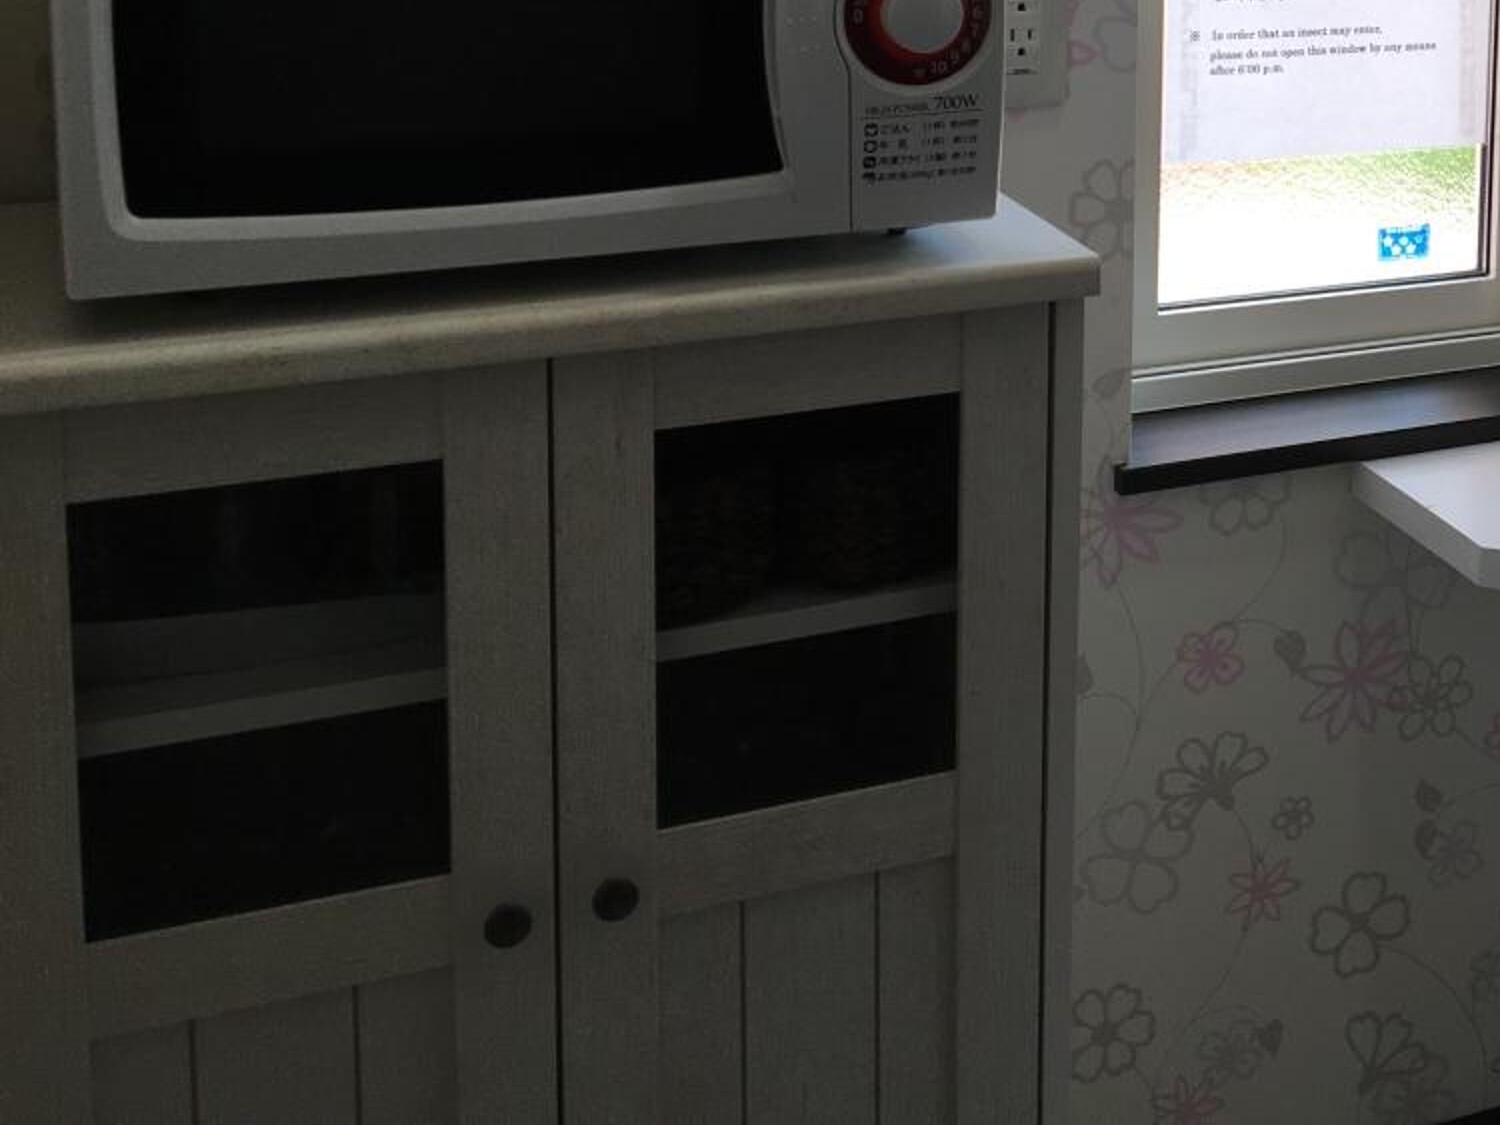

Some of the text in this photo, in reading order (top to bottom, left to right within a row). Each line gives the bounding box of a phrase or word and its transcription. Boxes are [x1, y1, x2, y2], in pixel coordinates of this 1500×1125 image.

[1212, 30, 1223, 41] In
[1226, 30, 1255, 40] order
[1258, 28, 1279, 38] that
[1282, 30, 1295, 38] an
[1298, 27, 1327, 37] insect
[1330, 27, 1350, 37] may
[1210, 49, 1242, 62] please
[1246, 48, 1259, 59] do
[1262, 48, 1278, 58] not
[1281, 49, 1305, 60] open
[1308, 45, 1326, 56] this
[1330, 43, 1366, 54] window
[1369, 42, 1381, 53] by
[1384, 43, 1401, 53] any
[1209, 65, 1235, 76] after
[1238, 64, 1260, 75] 6:00
[933, 93, 979, 109] 700W
